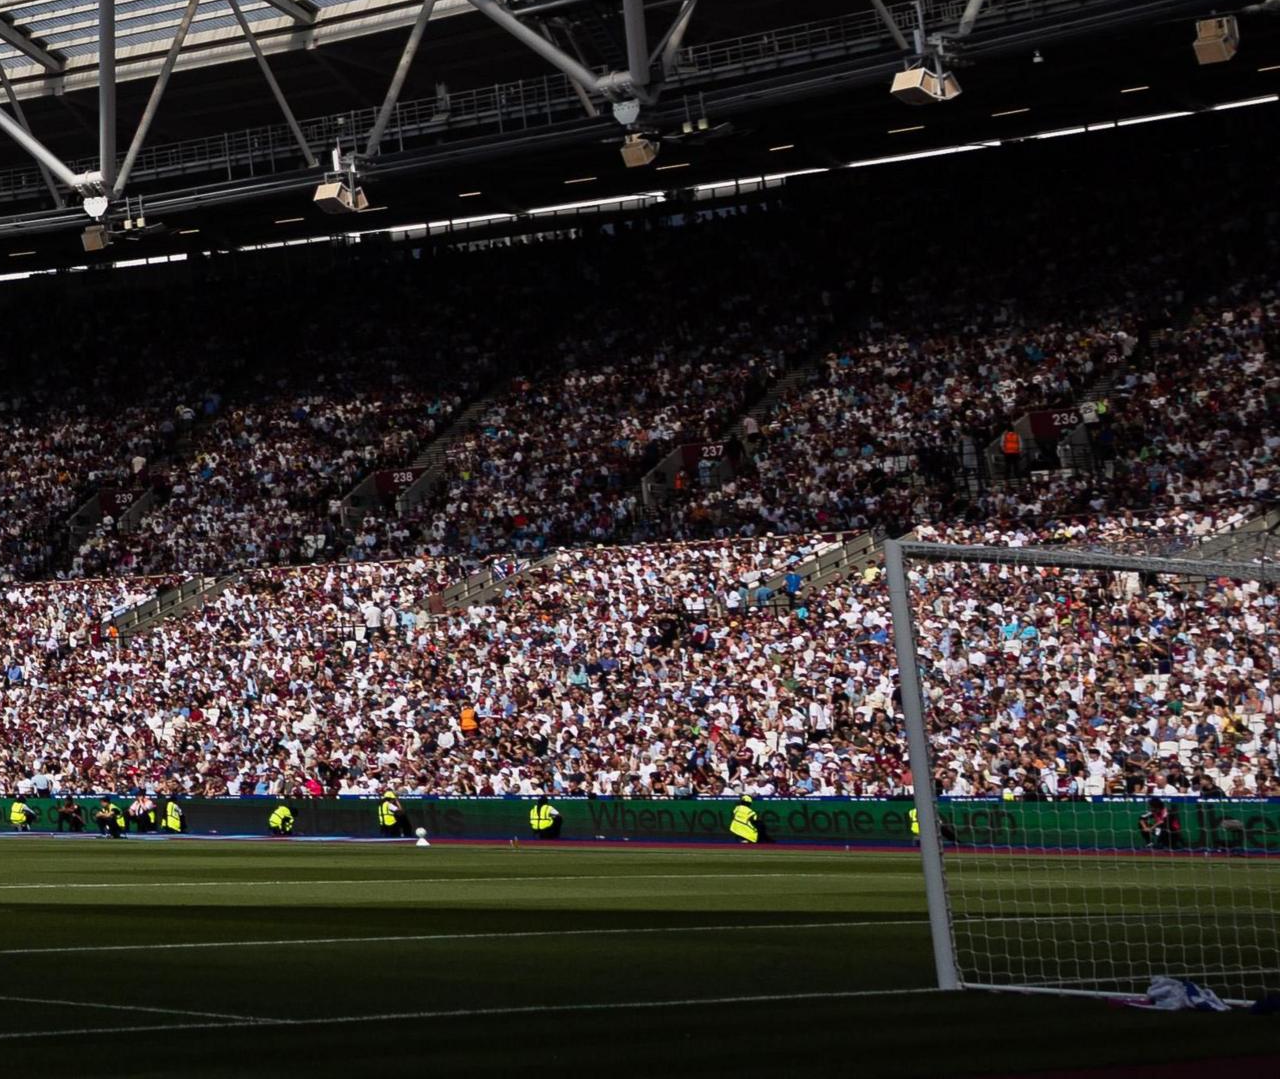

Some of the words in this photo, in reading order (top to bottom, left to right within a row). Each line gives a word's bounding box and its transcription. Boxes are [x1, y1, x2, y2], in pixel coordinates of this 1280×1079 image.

[1052, 413, 1079, 426] 236
[701, 445, 724, 457] 237
[393, 473, 413, 483] 238
[114, 494, 133, 504] 239
[588, 802, 675, 831] When
[788, 805, 873, 834] done
